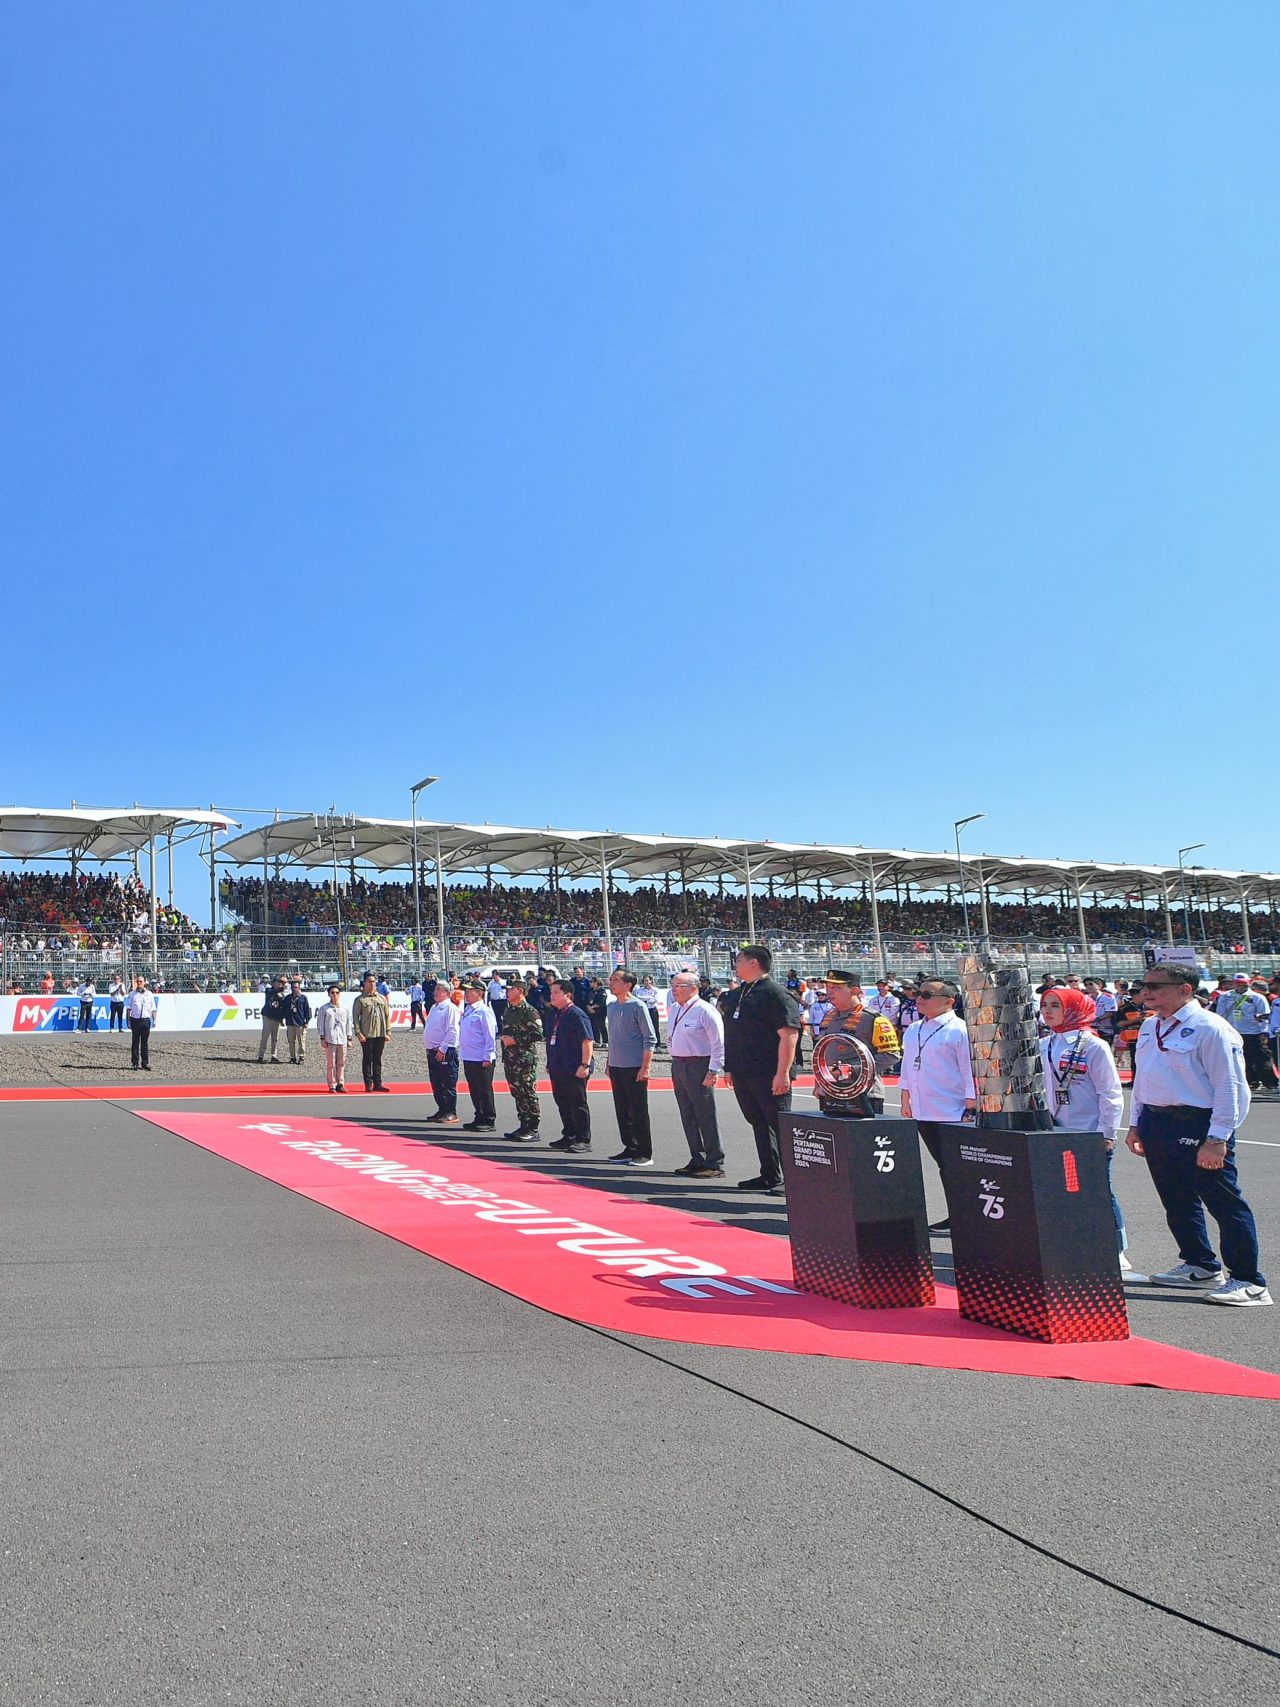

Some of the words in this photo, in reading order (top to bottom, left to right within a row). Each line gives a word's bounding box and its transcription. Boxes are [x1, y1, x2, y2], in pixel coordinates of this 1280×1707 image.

[793, 1139, 825, 1151] PERTAMINA
[793, 1145, 813, 1155] GRAND
[812, 1149, 826, 1158] PRIX
[279, 1140, 450, 1185] RACING
[795, 1160, 810, 1168] 2024
[801, 1154, 832, 1166] INDONESIA
[873, 1150, 896, 1173] 75
[431, 1183, 499, 1199] FOR
[978, 1193, 1005, 1220] 75
[437, 1199, 805, 1299] FUTURE
